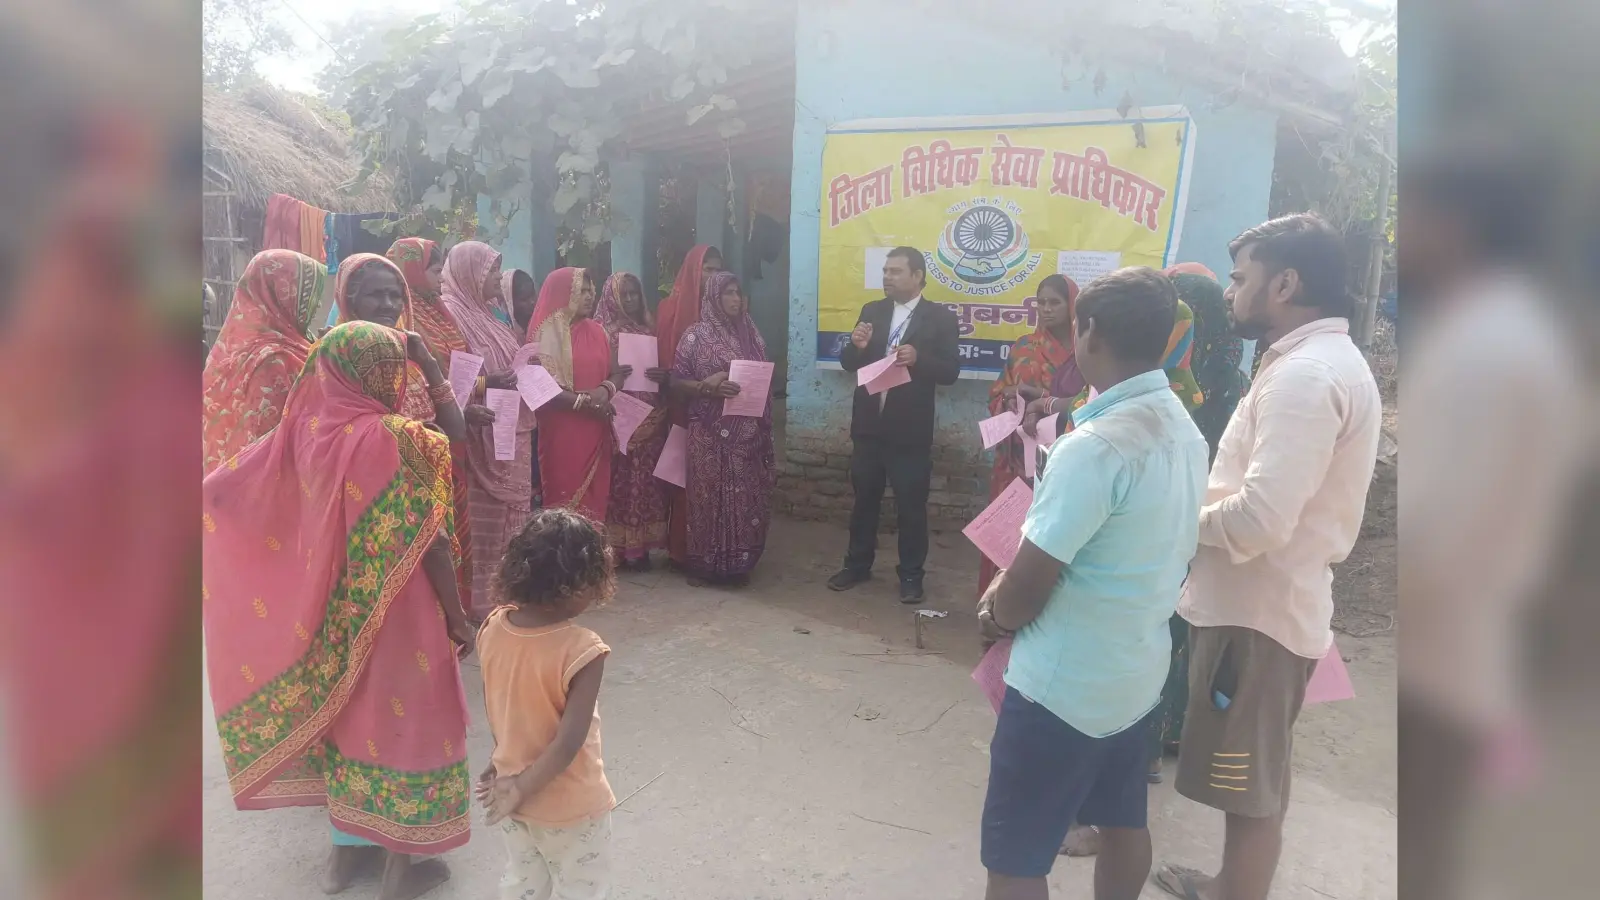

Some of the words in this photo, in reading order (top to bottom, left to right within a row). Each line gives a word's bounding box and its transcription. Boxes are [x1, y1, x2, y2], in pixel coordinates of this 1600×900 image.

[828, 166, 894, 226] जिला
[901, 140, 984, 197] विधिक
[990, 134, 1046, 188] सेवा
[1050, 146, 1166, 232] प्राधिकार
[923, 251, 949, 284] ACCESS
[950, 280, 963, 291] TO
[965, 284, 1009, 295] JUSTICE
[1010, 272, 1028, 287] FOR
[1027, 253, 1042, 273] ALL
